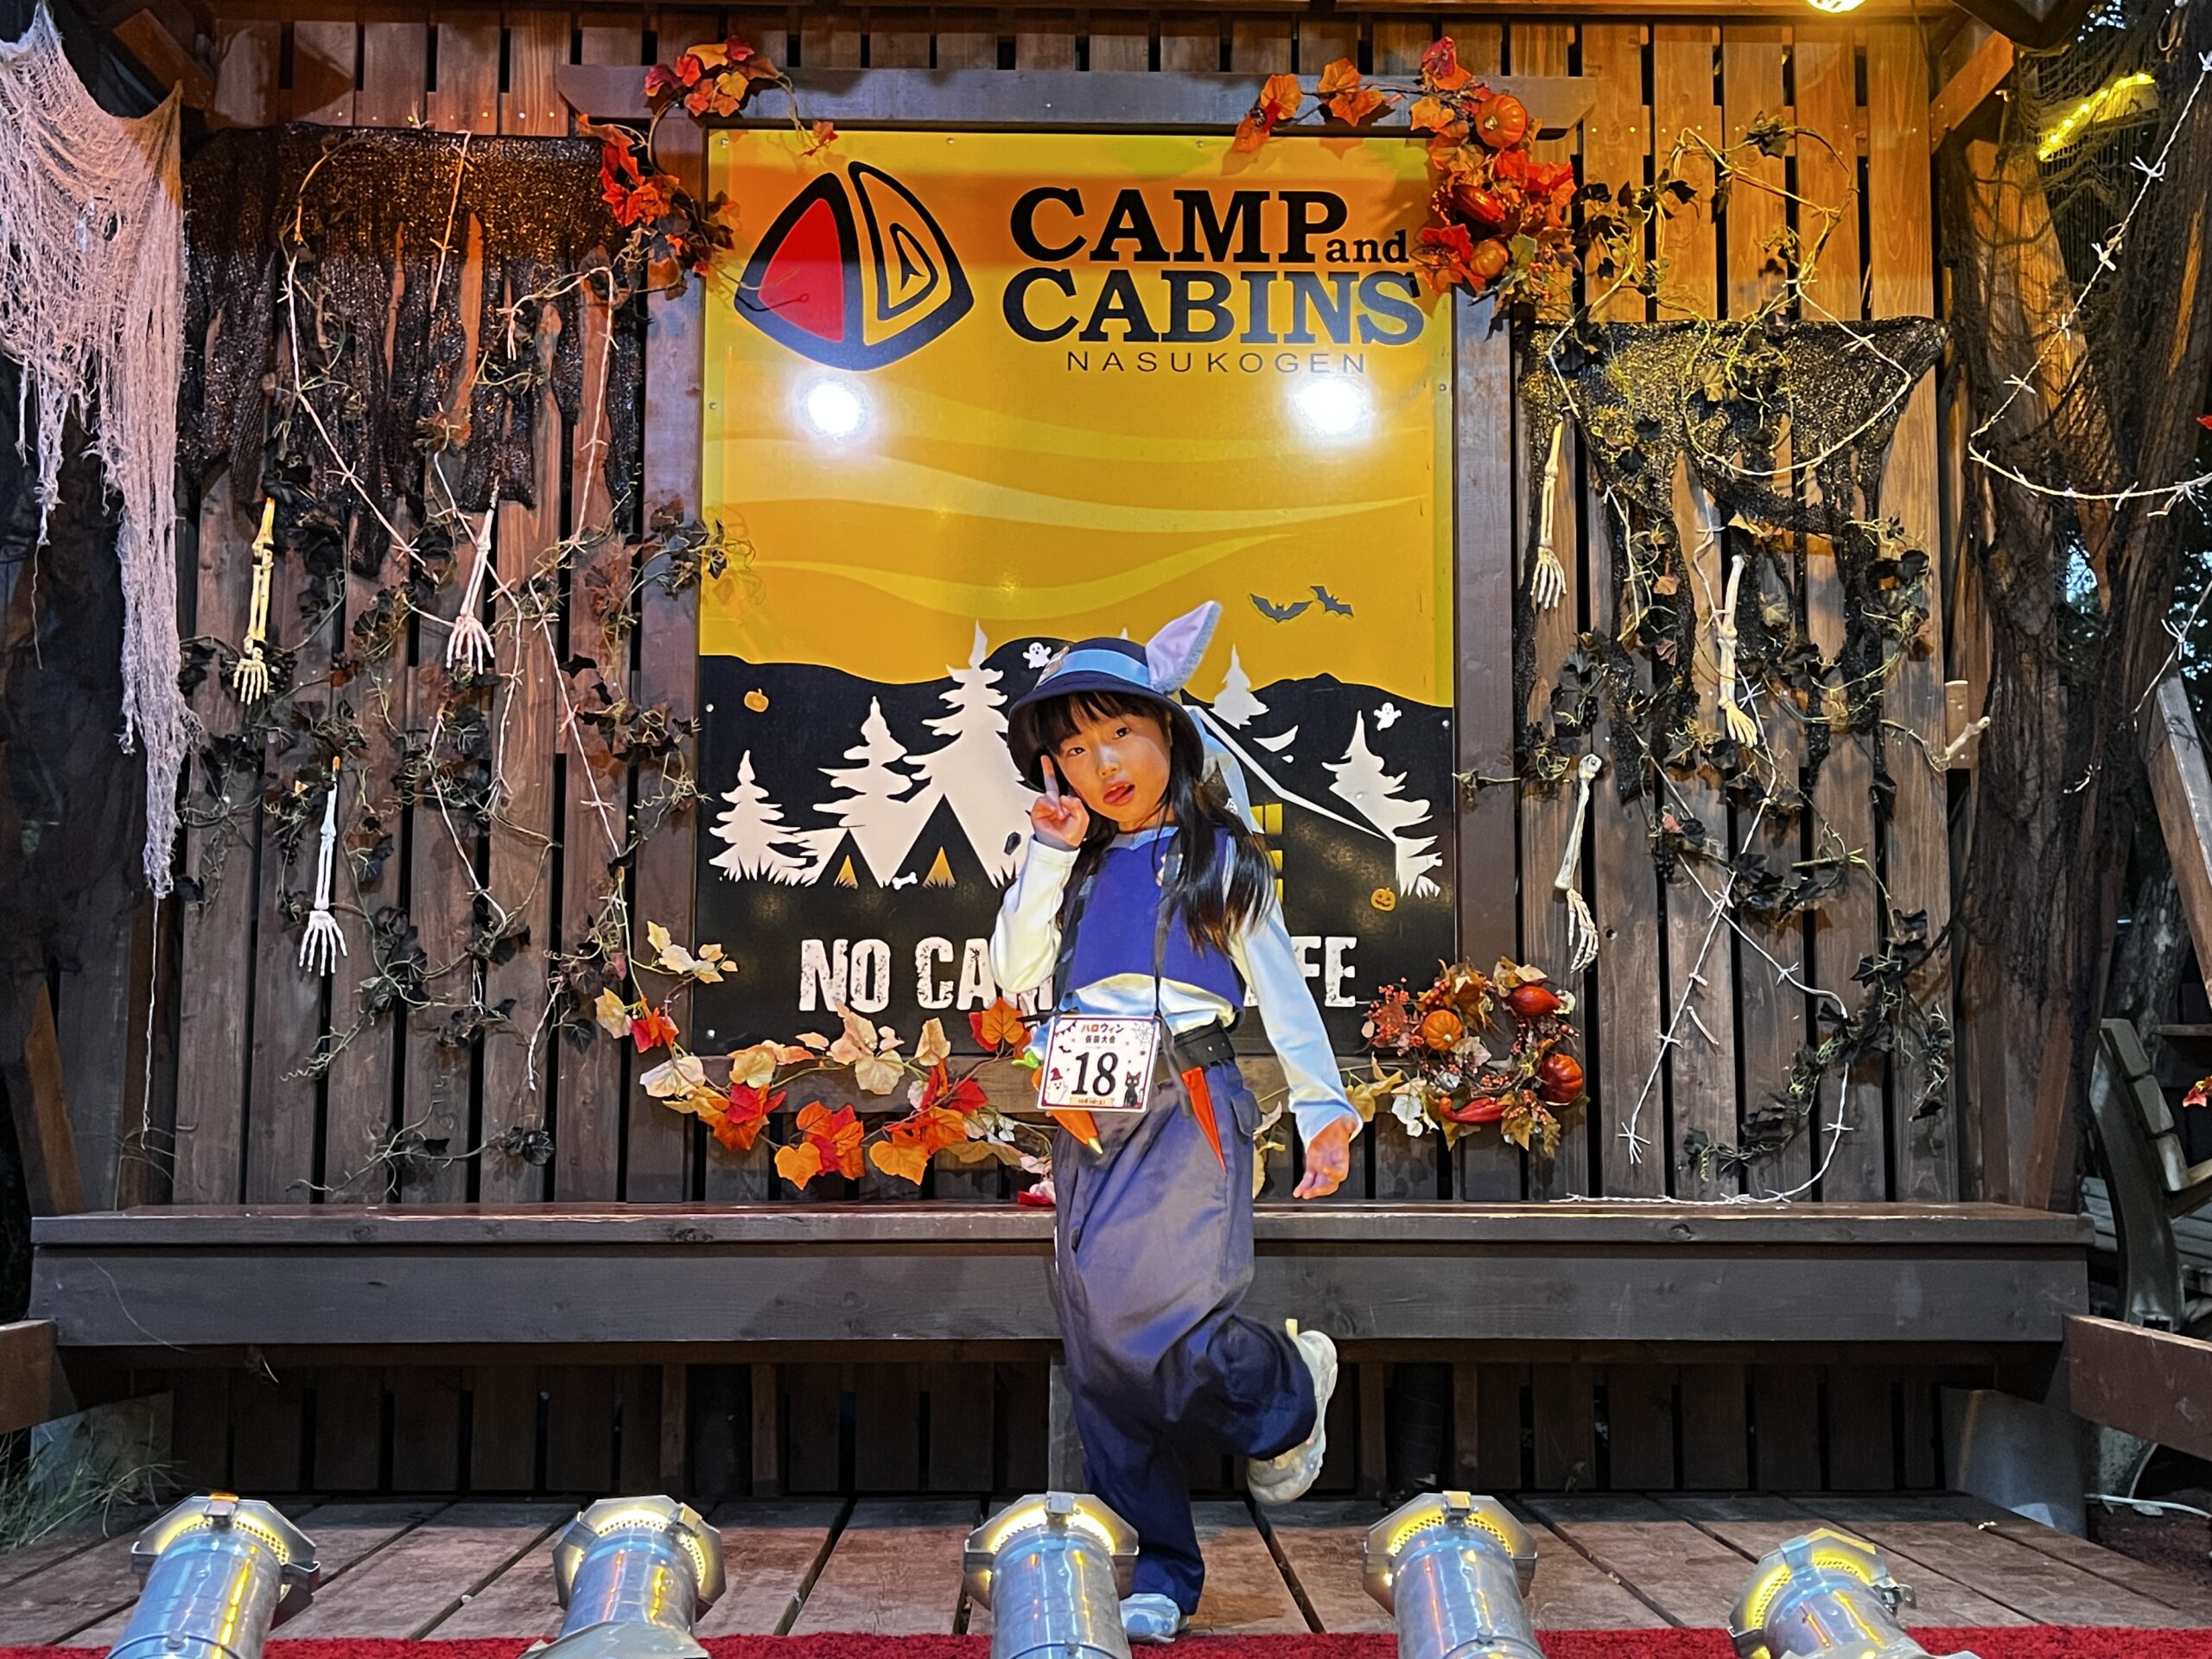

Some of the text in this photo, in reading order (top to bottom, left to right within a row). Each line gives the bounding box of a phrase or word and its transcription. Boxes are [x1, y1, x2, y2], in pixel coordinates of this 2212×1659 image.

[1010, 187, 1408, 263] CAMP and
[1002, 267, 1425, 345] CABINS
[1068, 351, 1364, 373] NASUKOGEN
[799, 938, 891, 1013] NO
[1081, 1023, 1125, 1033] ハロウィン
[1071, 1052, 1119, 1096] 18
